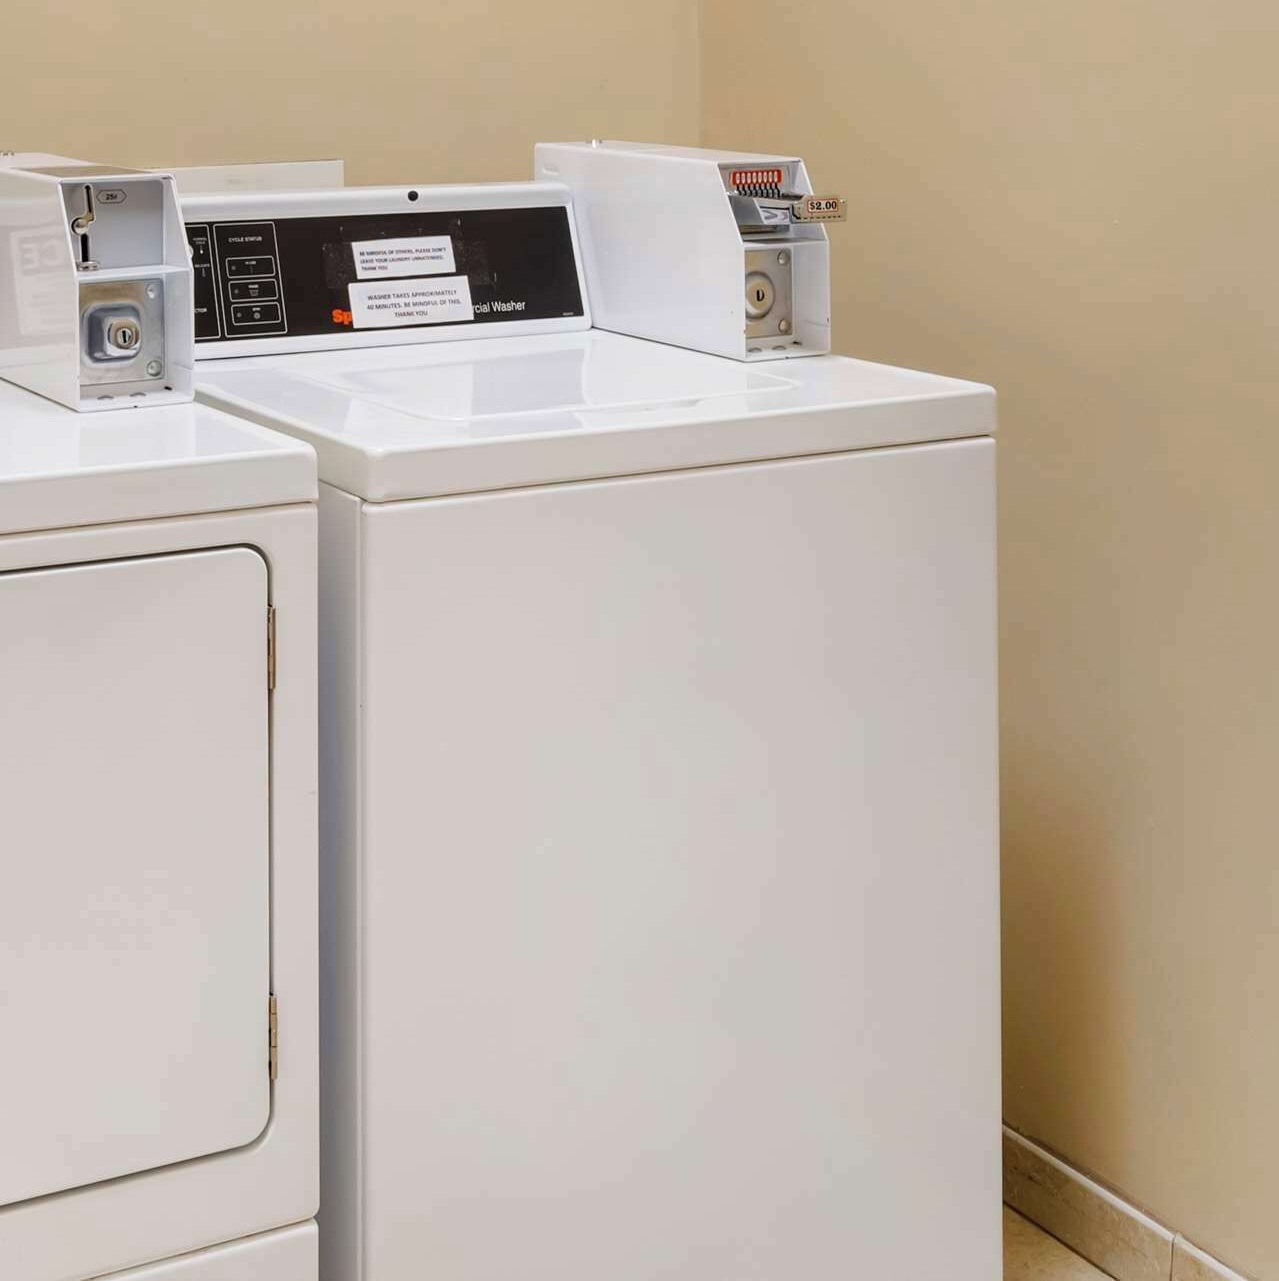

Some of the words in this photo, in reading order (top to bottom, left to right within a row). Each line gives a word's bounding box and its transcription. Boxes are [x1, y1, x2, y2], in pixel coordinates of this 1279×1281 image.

[809, 201, 837, 211] $2.00
[411, 290, 457, 298] APPROXIMATELY
[491, 300, 526, 312] Washer
